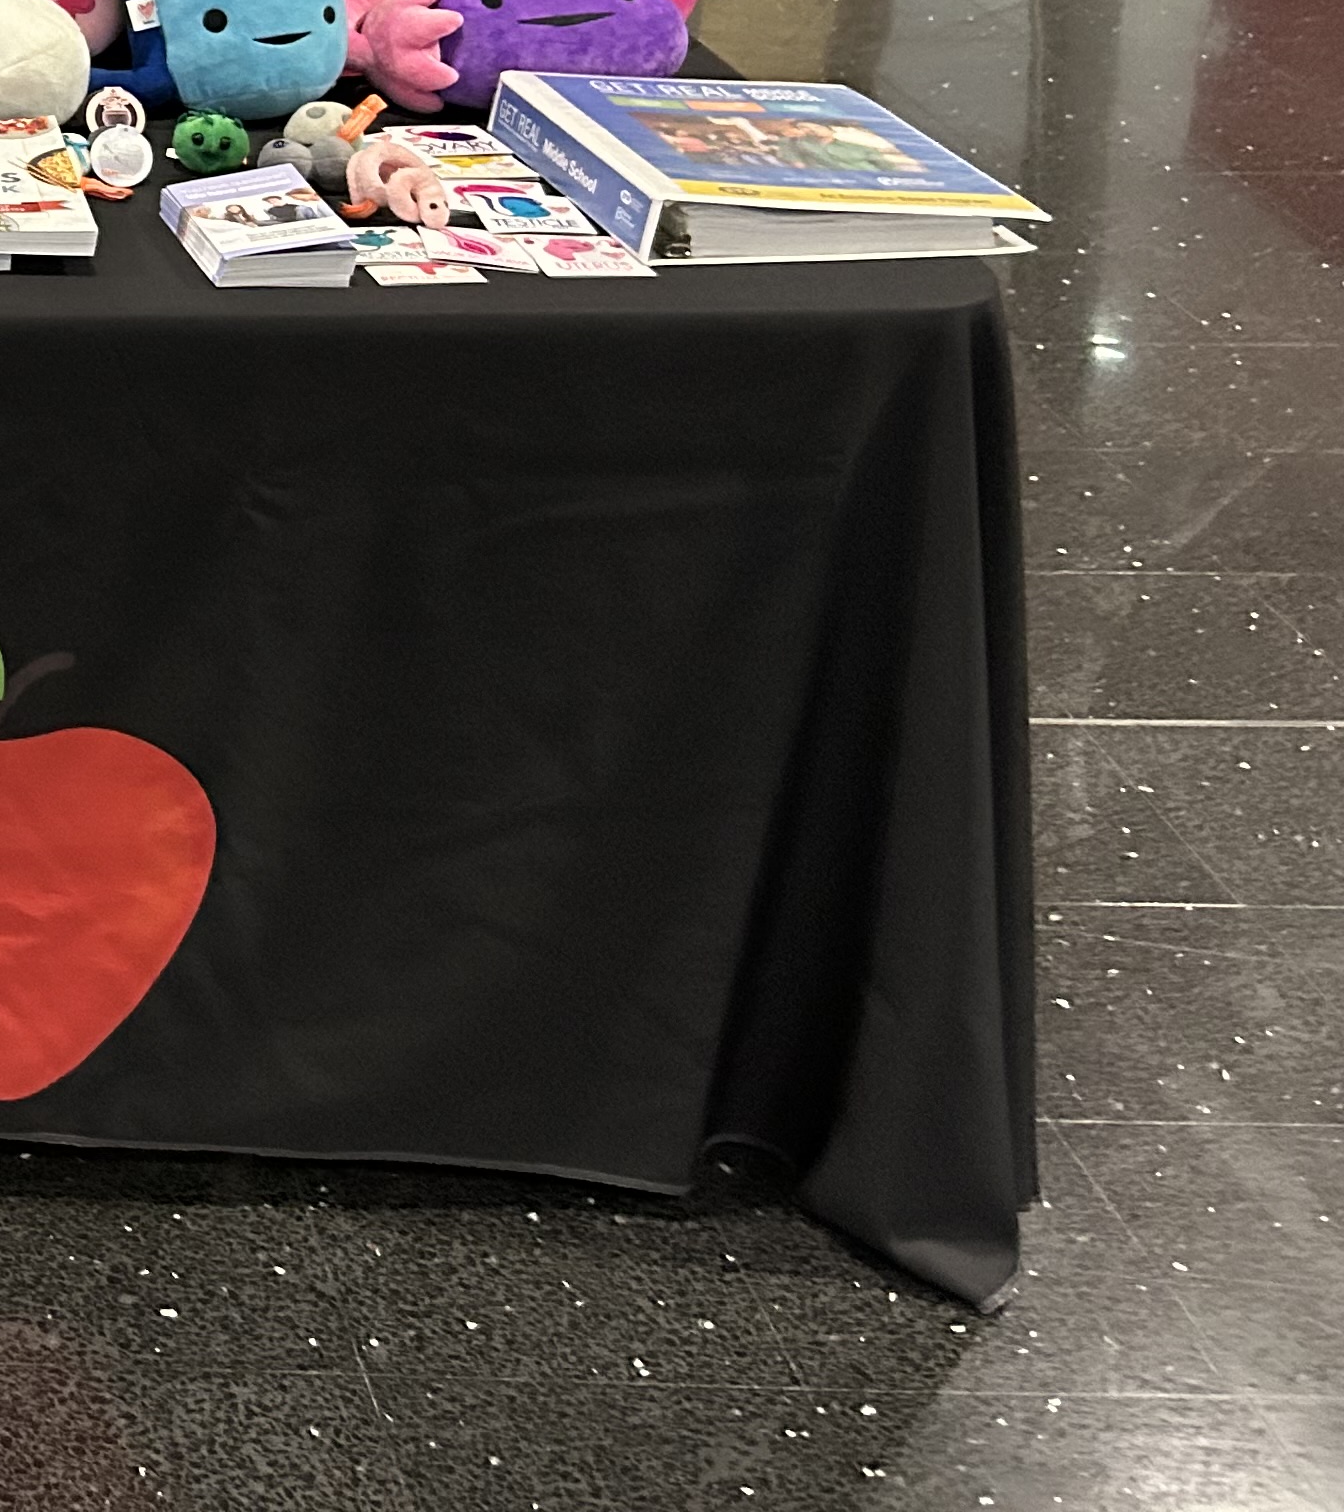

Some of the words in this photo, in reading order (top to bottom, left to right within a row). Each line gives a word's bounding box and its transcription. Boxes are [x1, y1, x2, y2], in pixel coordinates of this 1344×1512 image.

[589, 80, 647, 95] GET
[657, 84, 737, 99] REAL
[413, 141, 499, 152] OVARY
[499, 99, 519, 124] GET
[518, 113, 541, 147] REAL
[542, 138, 569, 171] Middle
[568, 159, 598, 194] School
[491, 219, 581, 228] TESTICLE
[555, 261, 634, 271] UTERUS
